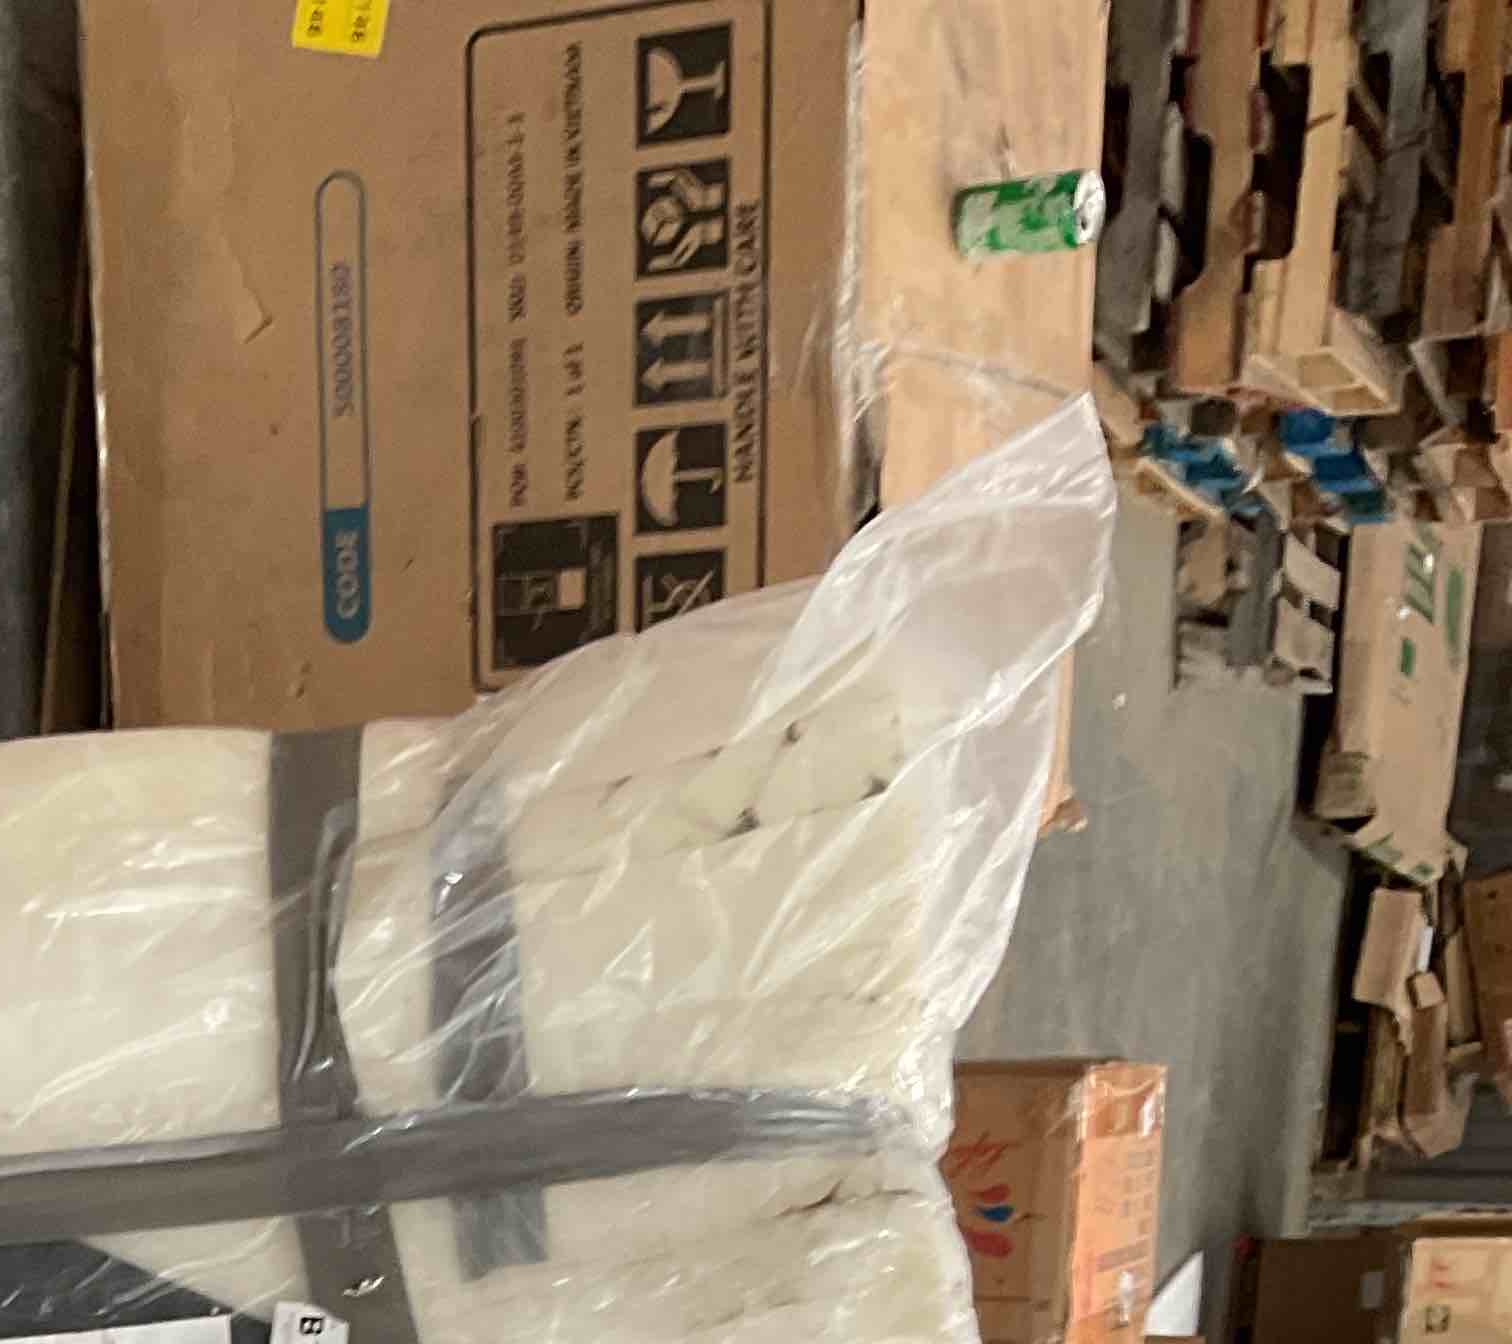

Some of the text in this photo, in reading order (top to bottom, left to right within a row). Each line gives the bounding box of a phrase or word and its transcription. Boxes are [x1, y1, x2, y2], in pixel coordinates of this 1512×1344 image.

[734, 201, 759, 484] HANDLE WITH CARE
[335, 530, 360, 618] CODE
